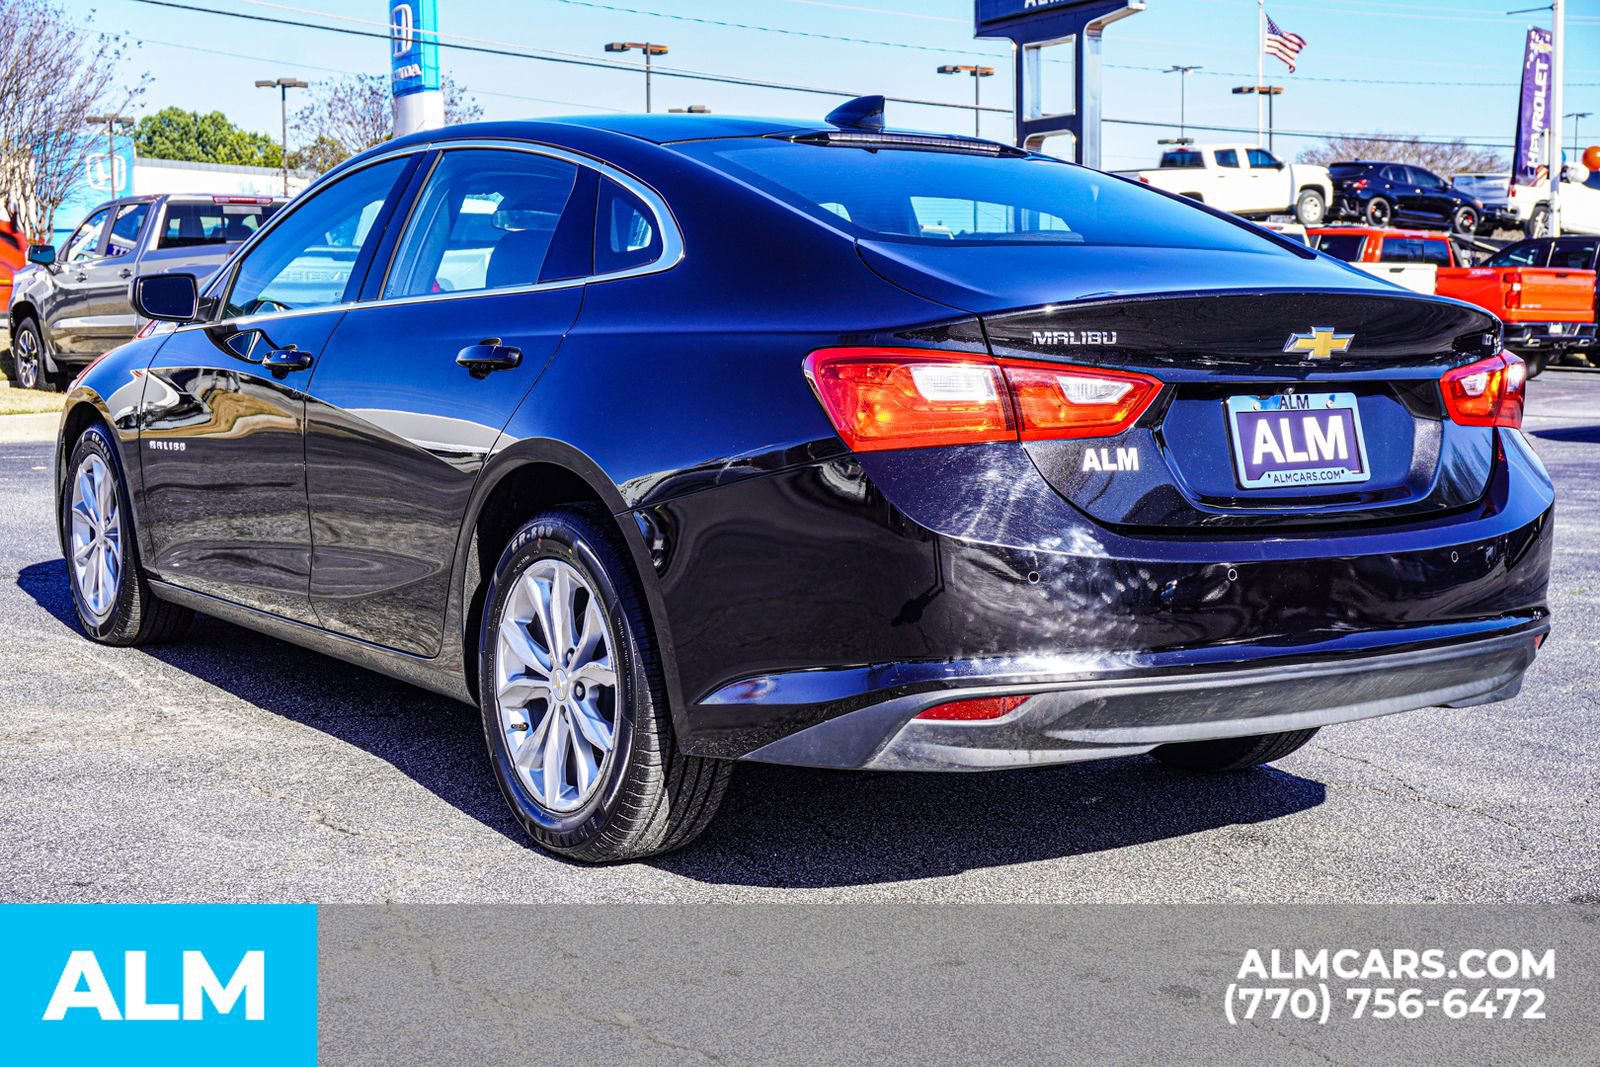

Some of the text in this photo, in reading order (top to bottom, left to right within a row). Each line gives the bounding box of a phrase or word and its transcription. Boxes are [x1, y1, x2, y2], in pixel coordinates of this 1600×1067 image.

[1032, 331, 1117, 345] MALIBU
[1279, 395, 1310, 410] ALM
[149, 440, 186, 451] MALIBU
[1252, 415, 1349, 465] ALM
[1082, 447, 1140, 471] ALM
[1273, 470, 1342, 484] ALMCARS.COM
